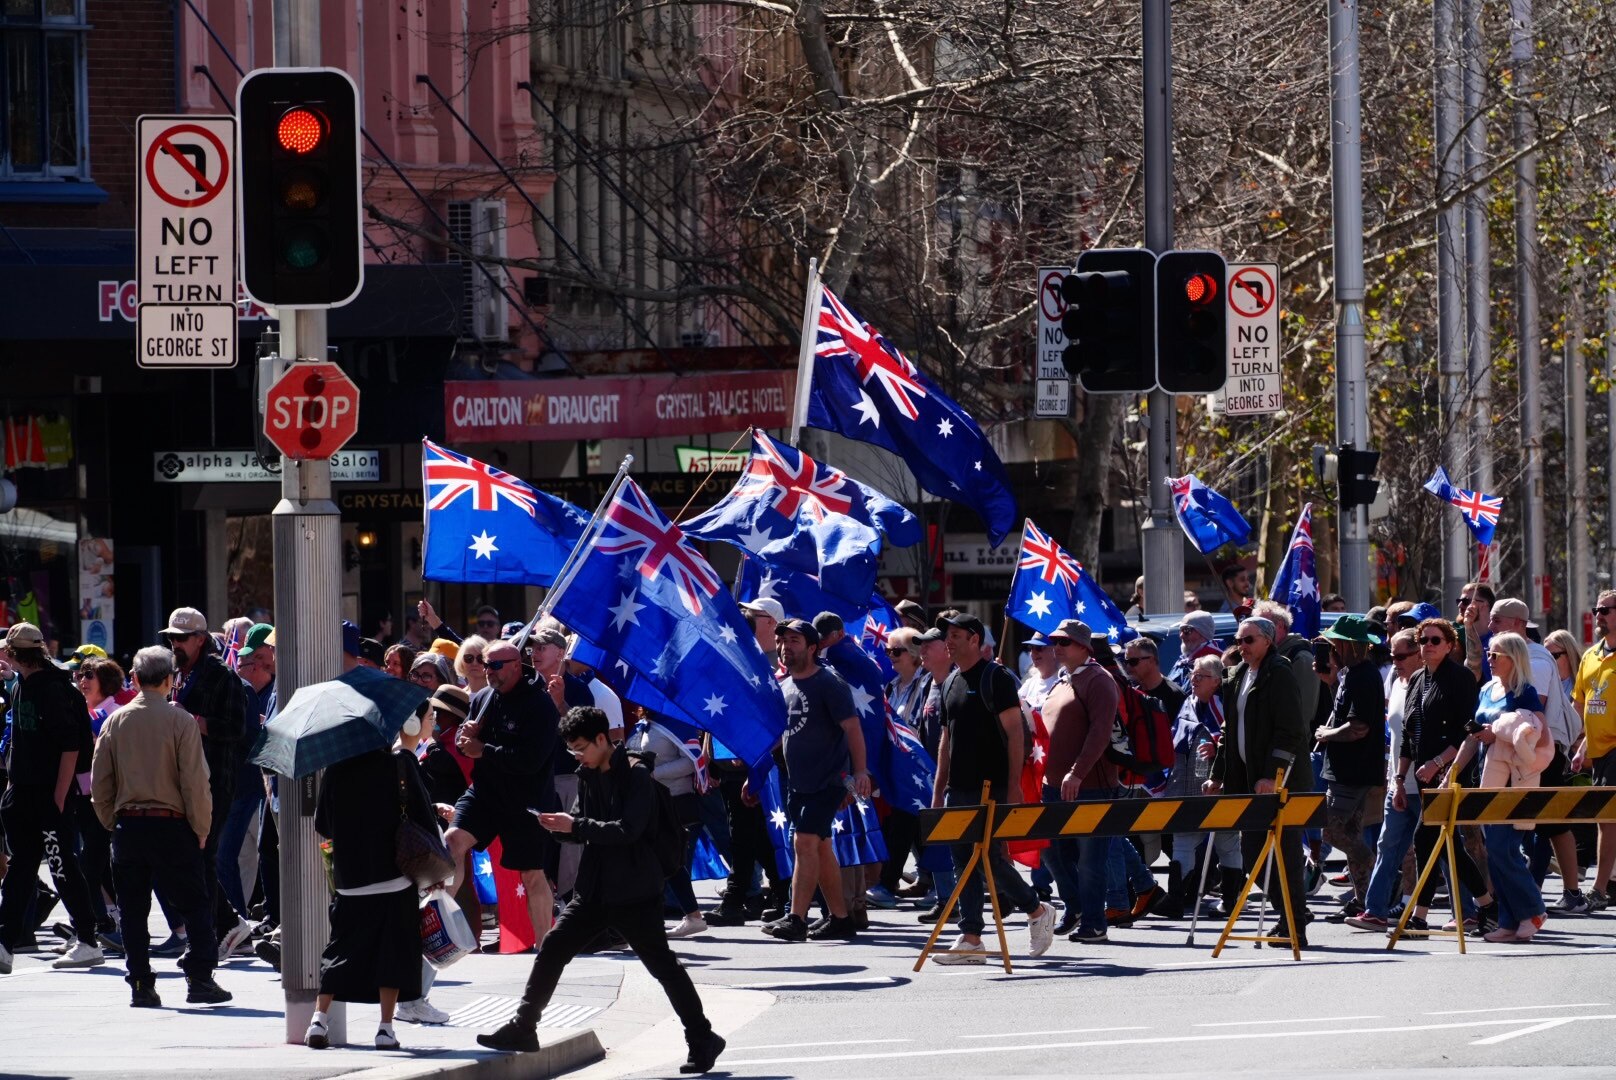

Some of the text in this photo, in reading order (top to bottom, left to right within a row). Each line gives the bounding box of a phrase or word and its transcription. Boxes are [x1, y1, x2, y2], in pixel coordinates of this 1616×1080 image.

[161, 217, 213, 246] NO
[155, 255, 219, 275] LEFT
[152, 284, 222, 302] TURN
[170, 312, 204, 332] INTO
[1045, 327, 1062, 345] NO
[1238, 325, 1268, 343] NO
[146, 337, 228, 357] GEORGE ST
[1233, 347, 1270, 359] LEFT
[1041, 367, 1066, 378] TURN
[1231, 362, 1273, 375] TURN
[1046, 384, 1059, 396] INTO
[1239, 378, 1265, 393] INTO
[452, 394, 620, 427] CARLTON DRAUGHT
[655, 387, 786, 420] CRYSTAL PALACE HOTEL
[1039, 400, 1068, 411] GEORGE ST
[1228, 395, 1265, 411] GEORGE
[1268, 394, 1280, 408] ST
[272, 395, 350, 430] STOP
[186, 452, 232, 471] alpha
[330, 451, 378, 467] Salon
[342, 493, 424, 508] CRYSTAL
[977, 556, 1017, 565] HOBB
